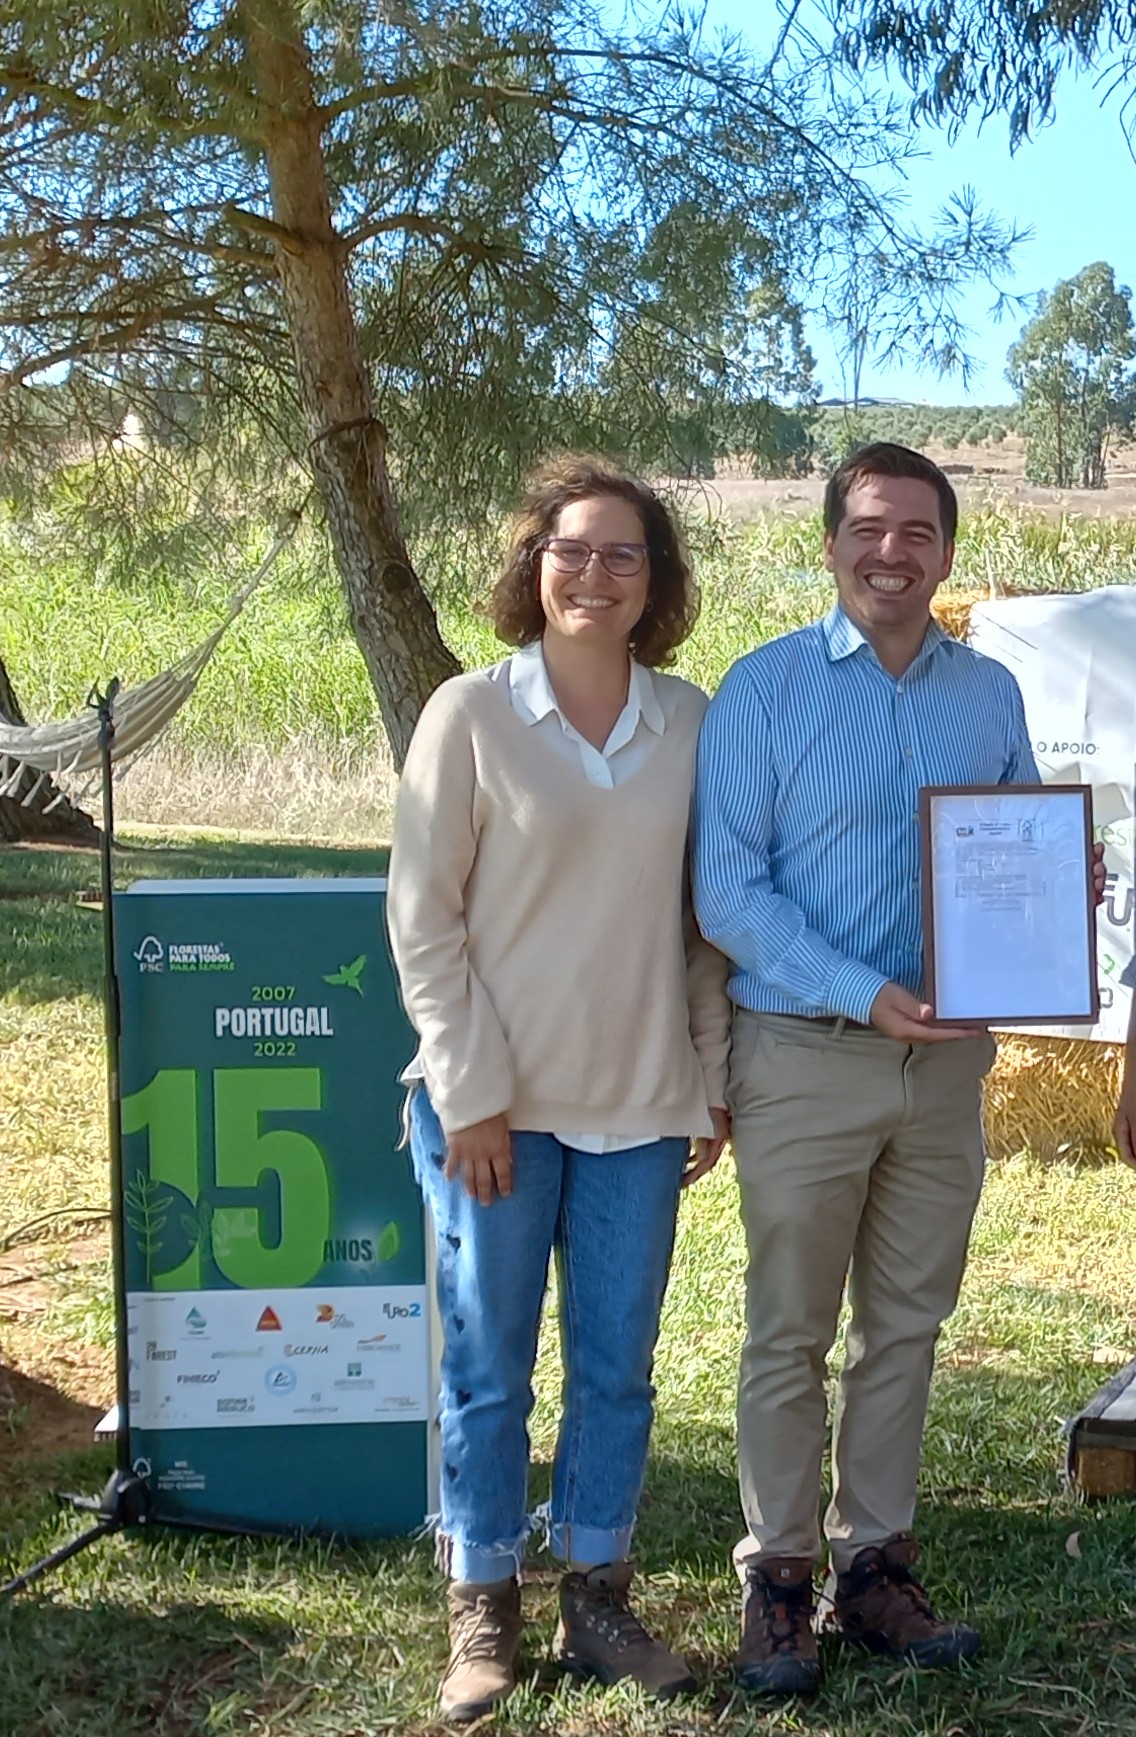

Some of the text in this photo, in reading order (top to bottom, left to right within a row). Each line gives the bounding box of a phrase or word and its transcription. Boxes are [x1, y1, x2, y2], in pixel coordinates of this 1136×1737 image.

[251, 986, 296, 1001] 2007
[215, 1006, 334, 1037] PORTUGAL
[254, 1042, 297, 1057] 2022
[121, 1068, 373, 1290] 15 ANOS
